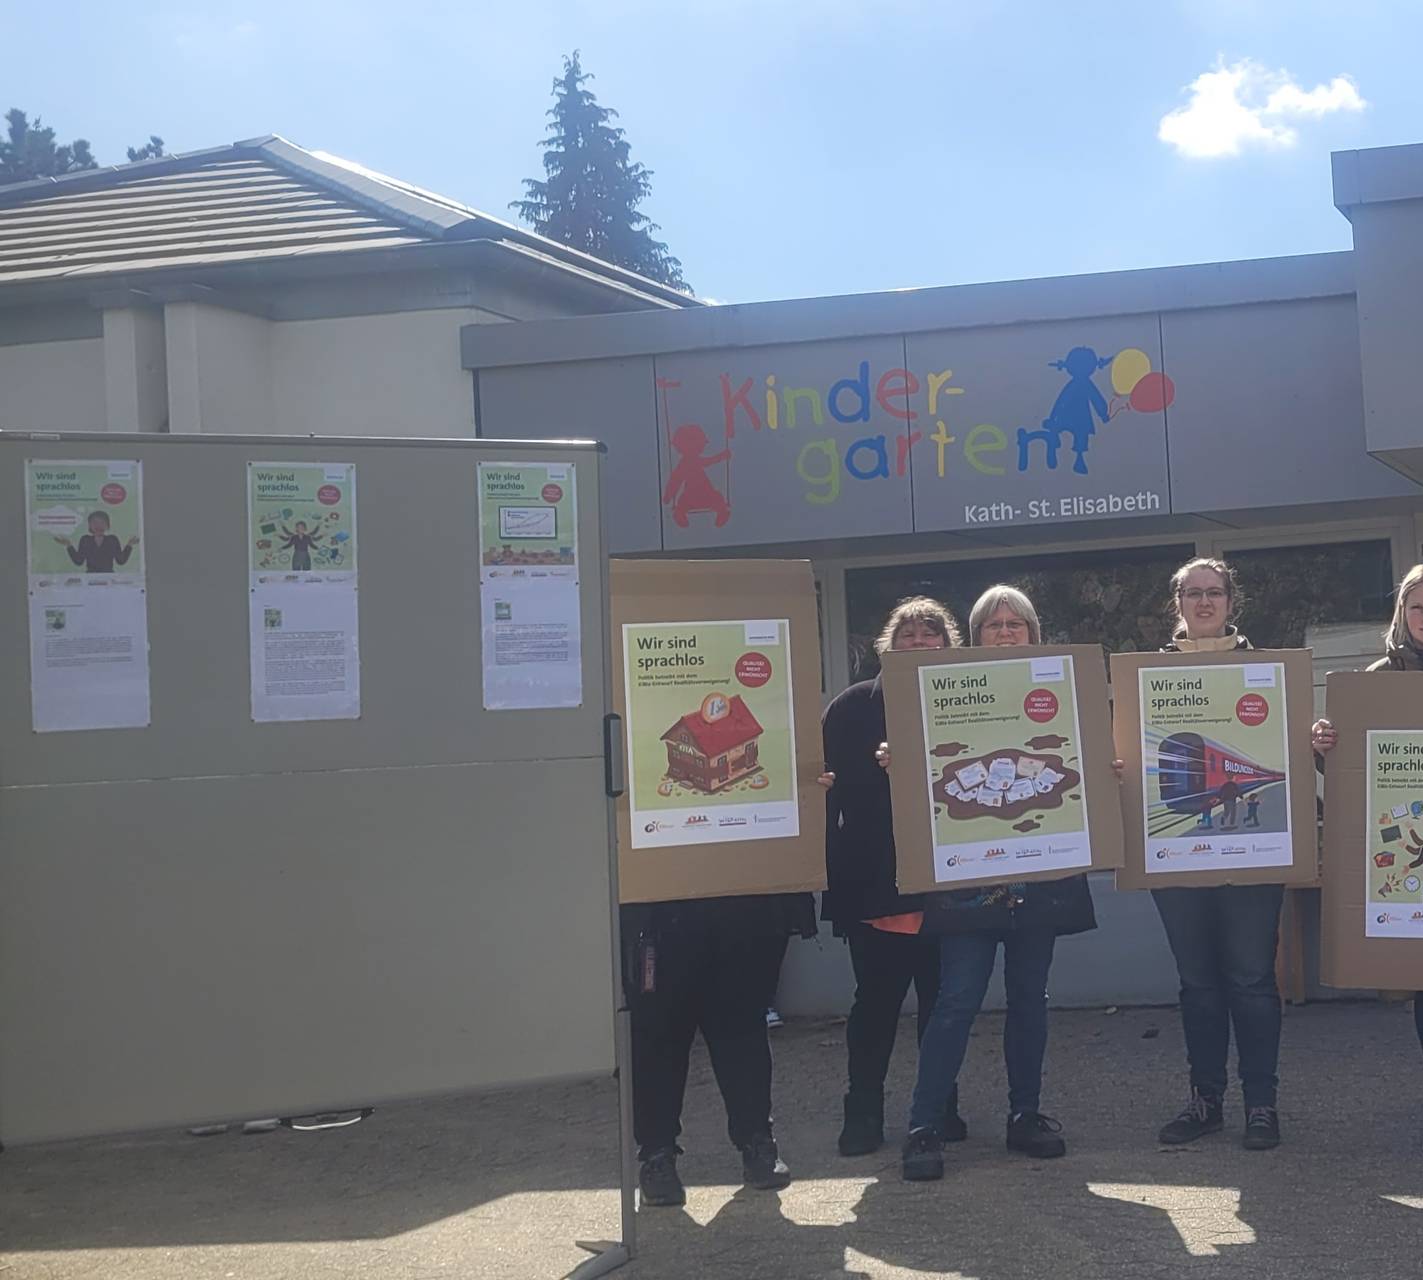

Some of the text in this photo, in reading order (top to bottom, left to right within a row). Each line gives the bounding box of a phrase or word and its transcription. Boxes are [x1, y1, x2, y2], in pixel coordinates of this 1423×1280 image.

[796, 420, 1058, 505] garten
[1028, 500, 1056, 518] St.
[1060, 490, 1160, 516] Elisabeth
[637, 635, 696, 650] Wir sind
[638, 653, 704, 671] sprachlos
[932, 674, 987, 690] Wir sind
[1151, 678, 1202, 691] Wir sind
[934, 692, 995, 711] sprachlos
[1152, 695, 1209, 710] sprachlos
[1378, 743, 1400, 754] Wir
